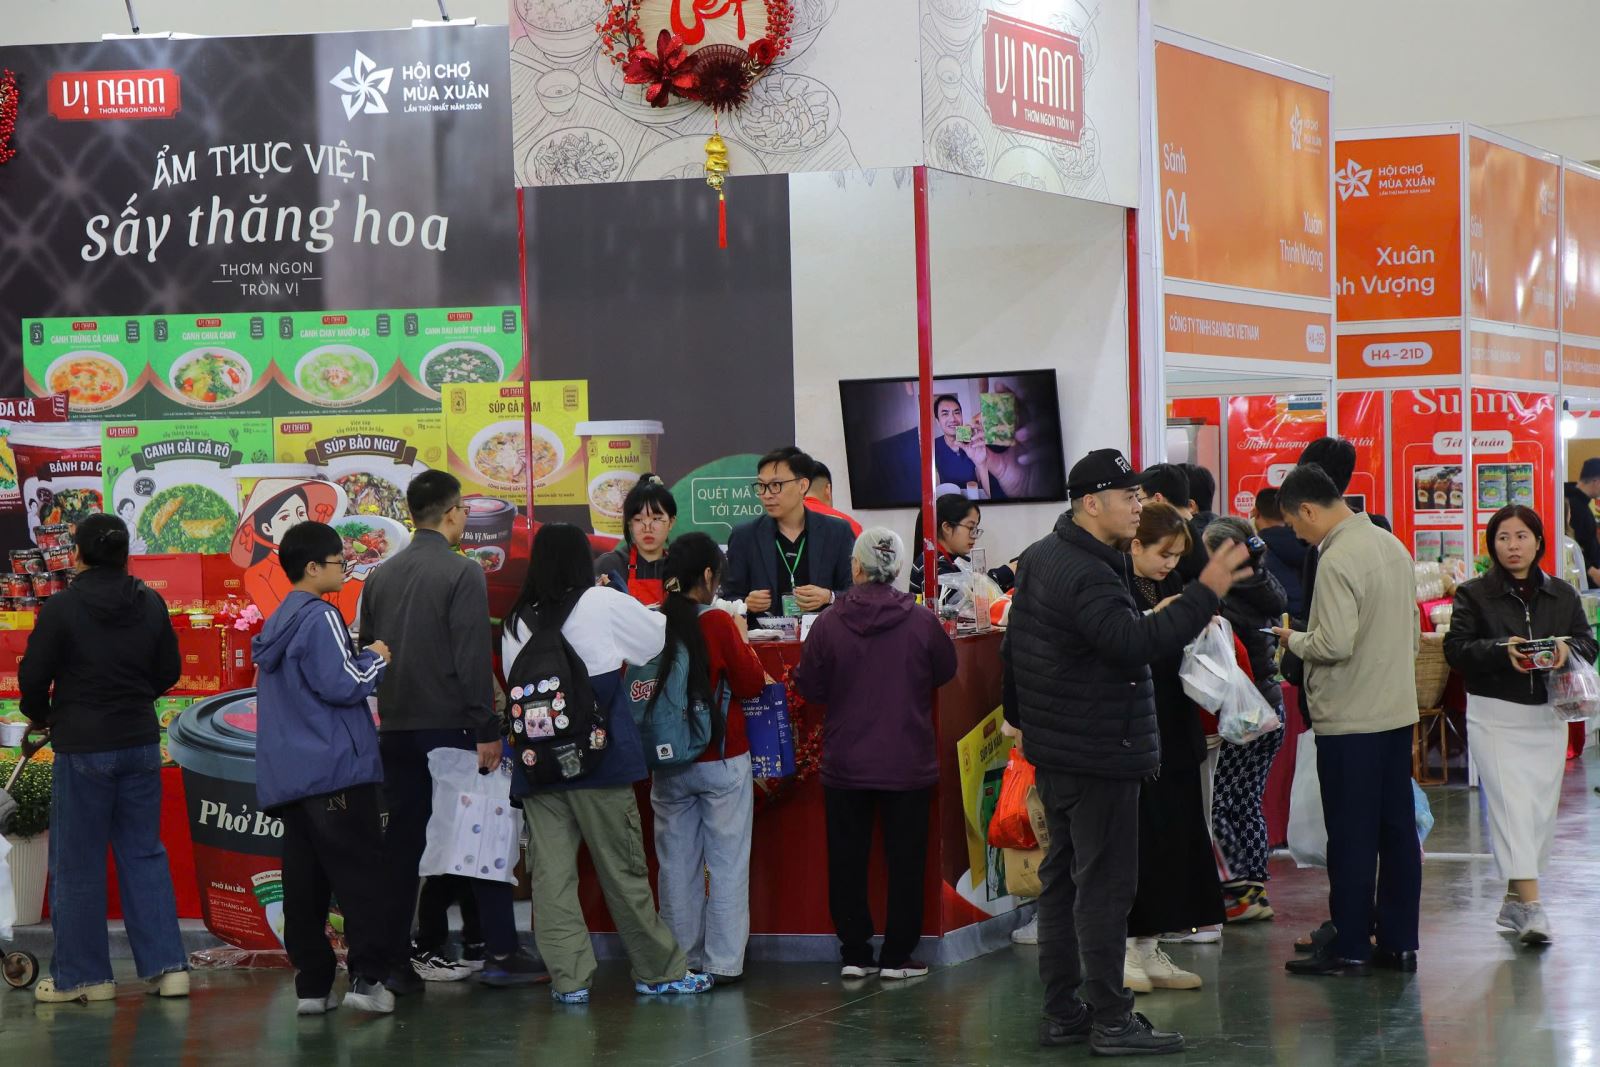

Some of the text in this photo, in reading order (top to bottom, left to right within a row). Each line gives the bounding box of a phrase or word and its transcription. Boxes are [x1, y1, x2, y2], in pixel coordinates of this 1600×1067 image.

[402, 60, 471, 82] HỘI CHỢ
[994, 33, 1075, 118] VỊ NAM
[62, 77, 165, 115] VỊ NAM
[403, 80, 490, 101] MÙA XUÂN
[99, 107, 118, 115] THƠM
[140, 105, 157, 113] TRÒN
[450, 102, 465, 110] NĂM
[1024, 108, 1040, 124] THƠM
[1040, 111, 1056, 126] NGON
[1056, 115, 1070, 131] TRÒN
[152, 140, 376, 190] ẨM THỰC VIỆT
[1164, 143, 1186, 174] Sảnh
[1378, 163, 1424, 177] HỘI CHỢ
[1379, 175, 1435, 189] MÙA XUÂN
[1166, 188, 1190, 243] 04
[1304, 211, 1323, 235] Xuân
[188, 194, 341, 254] thăng
[353, 194, 449, 252] hoa
[1280, 240, 1323, 272] Thịnh Vượng
[1376, 245, 1435, 266] Xuân
[220, 261, 314, 276] THƠM NGON
[1471, 251, 1484, 291] 04
[240, 281, 299, 297] TRÒN VỊ
[1361, 275, 1435, 299] Vượng
[300, 330, 317, 338] CANH
[319, 329, 337, 337] CHAY
[1169, 311, 1187, 332] CÔNG
[1187, 317, 1195, 332] TY
[1195, 319, 1212, 335] TNHH
[1236, 324, 1260, 341] VIETNAM
[51, 335, 69, 344] CANH
[103, 335, 120, 343] CHUA
[182, 331, 236, 340] CANH CHUA CHAY
[1371, 347, 1425, 361] H4-21D
[18, 398, 36, 417] CÁ
[488, 401, 506, 413] SÚP
[507, 400, 519, 413] GÀ
[118, 427, 136, 435] NAM
[144, 443, 174, 459] CANH
[197, 438, 212, 454] CÁ
[214, 442, 230, 458] RÔ
[324, 433, 400, 454] SÚP BÀO NGƯ
[1237, 437, 1273, 451] Thịnh
[1441, 437, 1463, 448] Tết
[49, 460, 78, 473] BÁNH
[80, 461, 93, 472] ĐA
[601, 454, 614, 464] SÚP
[615, 454, 624, 464] GÀ
[138, 485, 144, 494] 3
[697, 486, 728, 500] QUÉT
[732, 486, 751, 499] MÃ
[710, 503, 763, 516] TỚI ZALO
[482, 532, 498, 540] Nam
[198, 799, 285, 838] Phở Bò
[224, 883, 233, 891] ĂN
[221, 901, 240, 910] THĂNG
[240, 905, 253, 913] HOA
